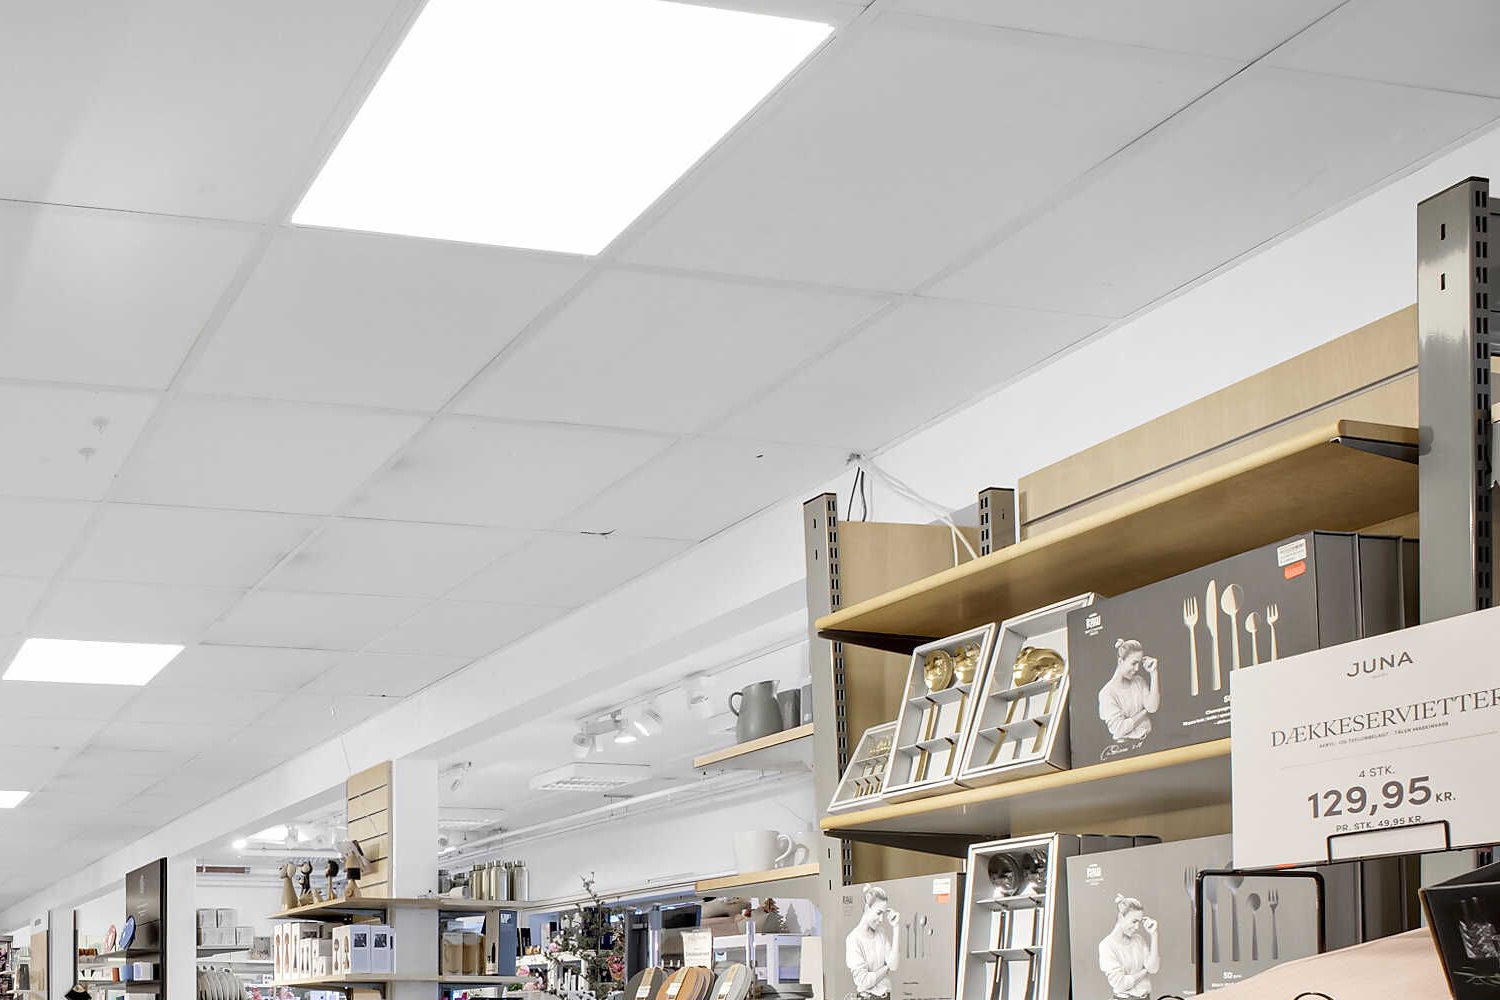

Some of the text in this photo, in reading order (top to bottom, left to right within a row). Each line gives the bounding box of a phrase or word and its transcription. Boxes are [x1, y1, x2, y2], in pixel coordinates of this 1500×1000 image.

[1346, 651, 1414, 677] JUNA
[1358, 764, 1396, 778] 4 STK.
[1307, 775, 1457, 819] 129,95 KR.
[1336, 815, 1426, 833] PR. STK. 49,95 KR.
